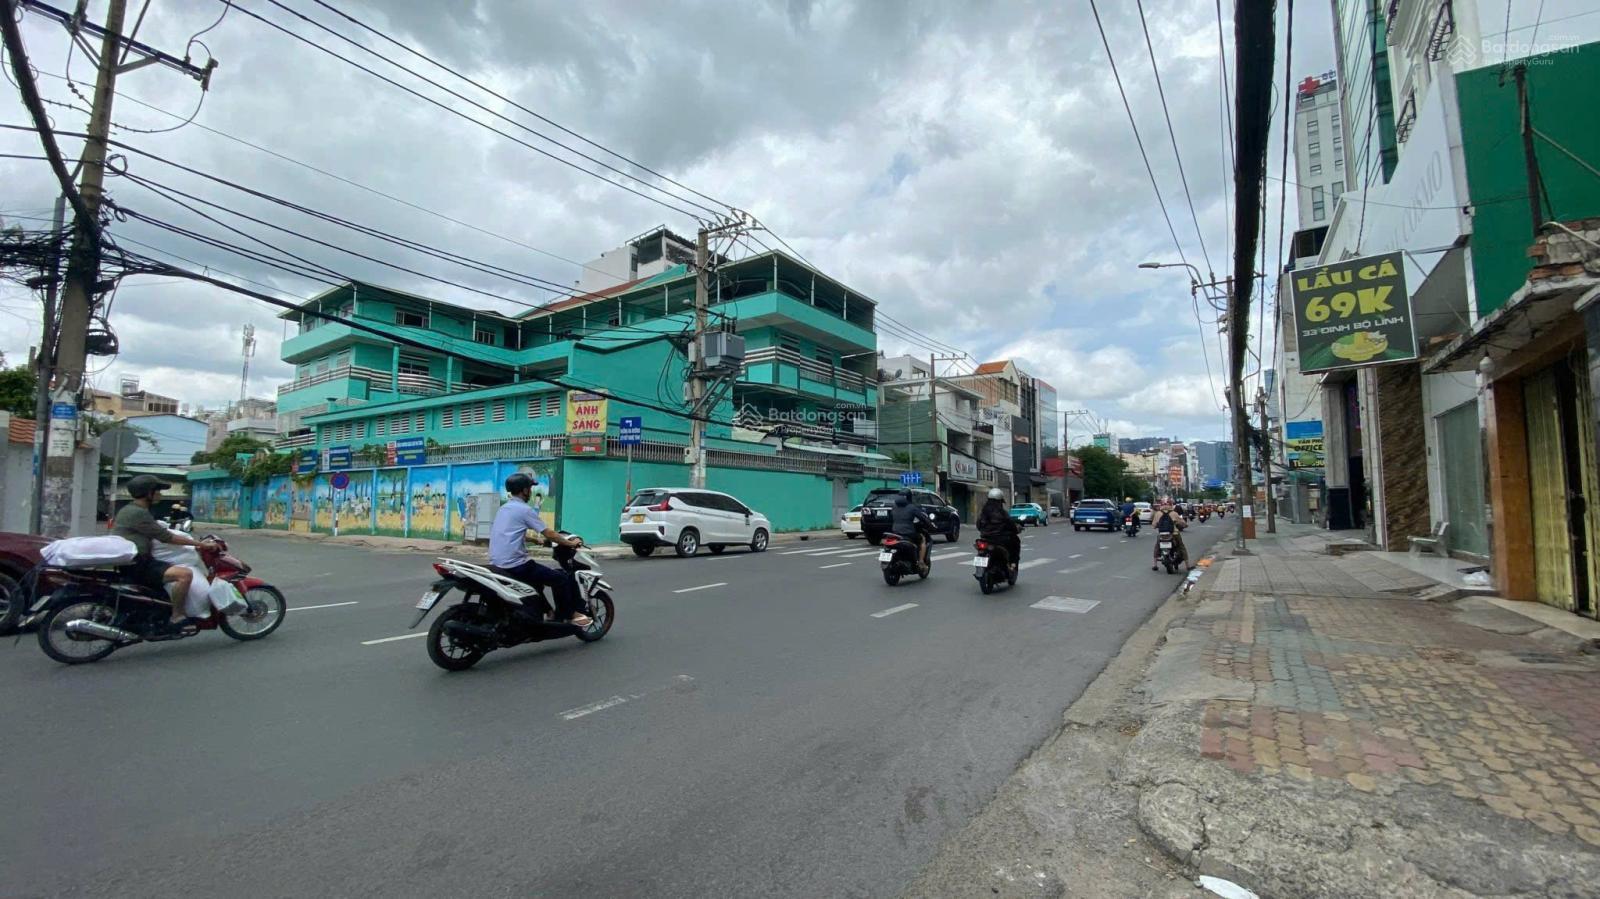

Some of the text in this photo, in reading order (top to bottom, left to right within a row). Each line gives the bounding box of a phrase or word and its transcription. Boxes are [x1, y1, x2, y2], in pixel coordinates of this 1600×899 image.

[1358, 258, 1398, 280] CÁ
[1305, 285, 1395, 322] 69K
[1302, 329, 1318, 337] 33
[1320, 323, 1351, 335] ĐINH
